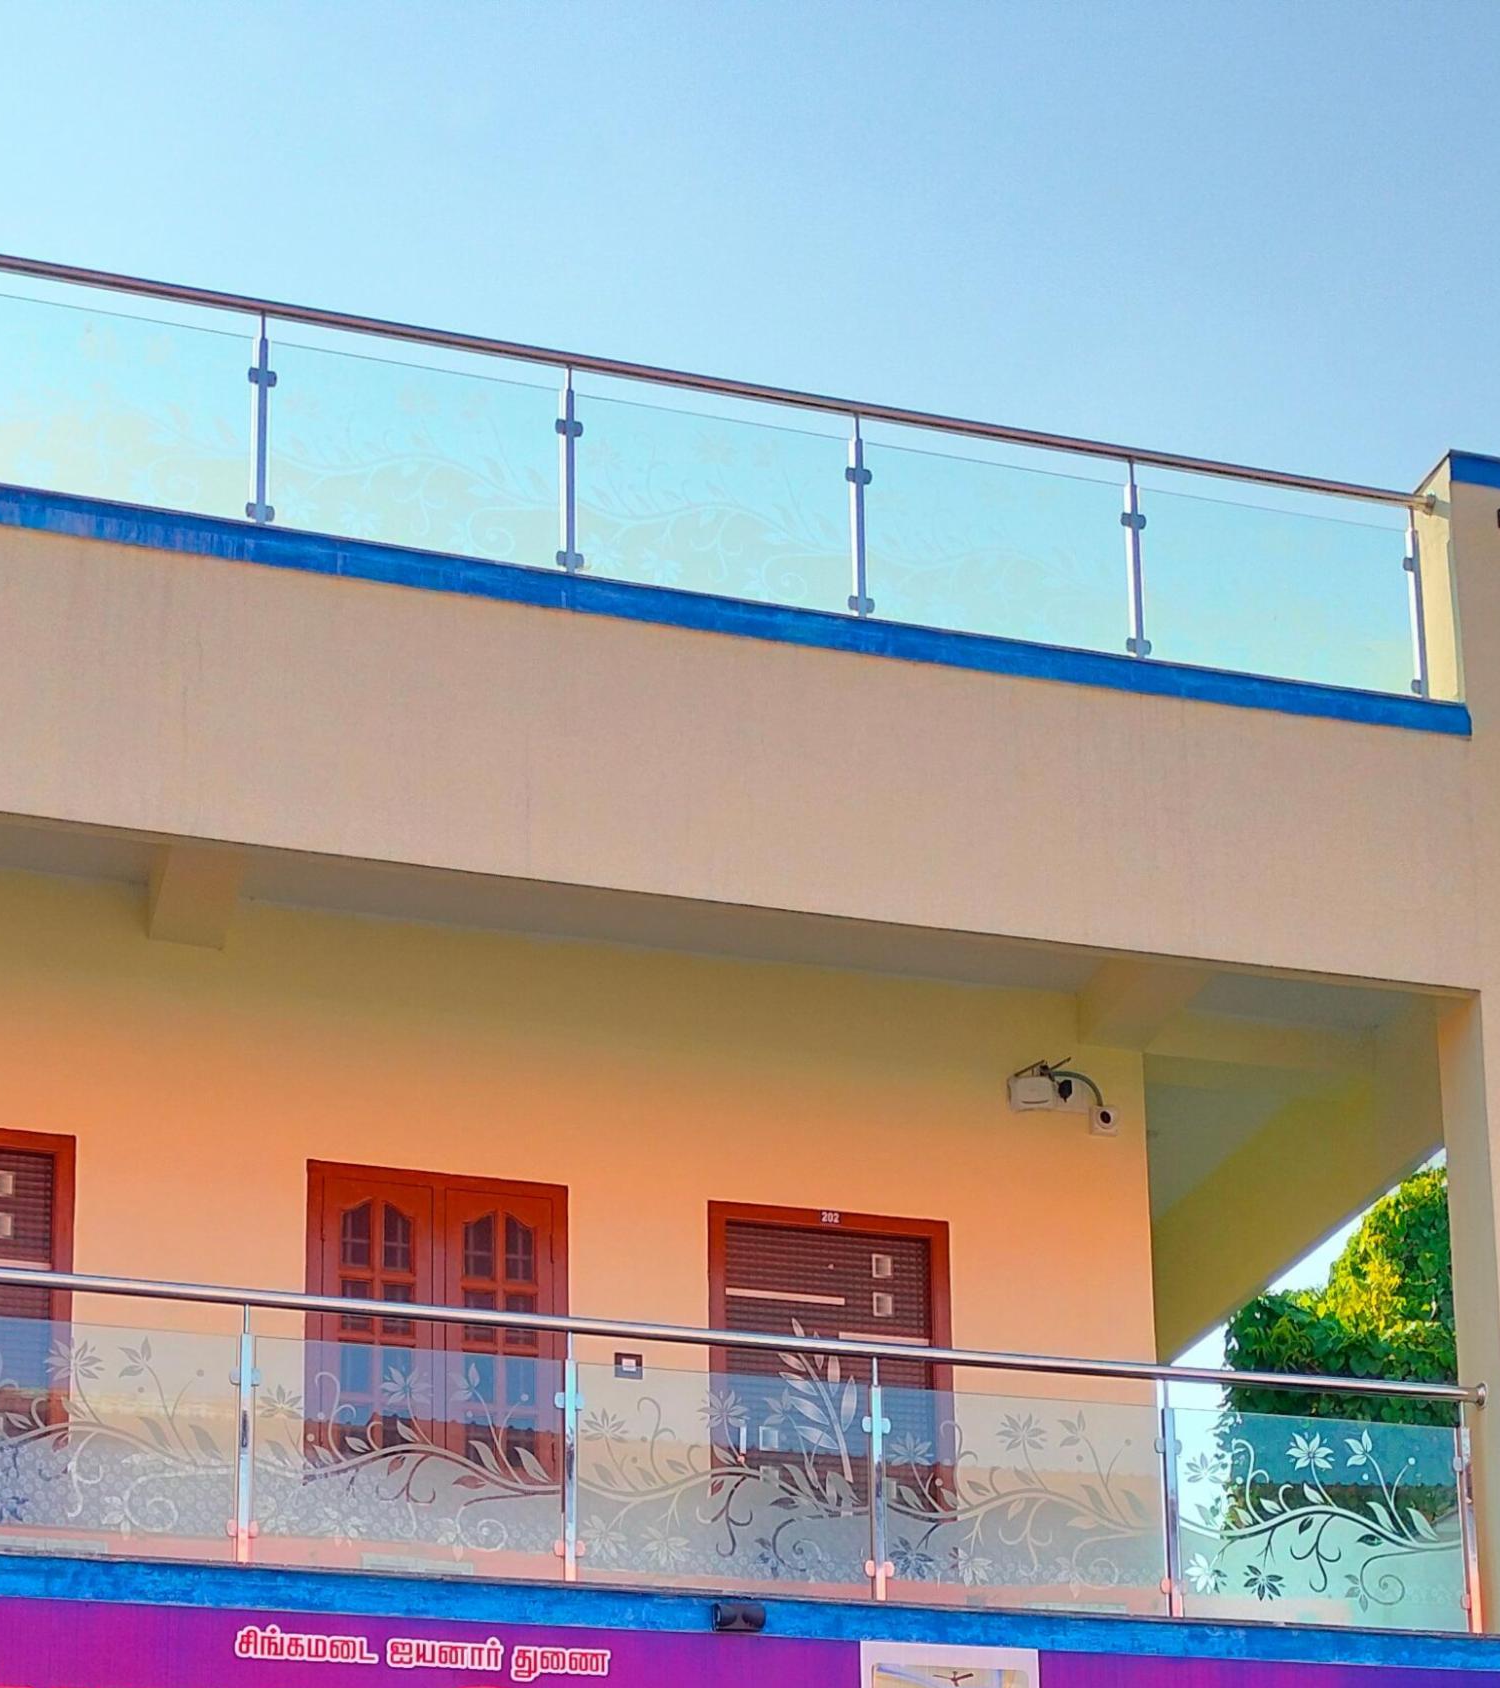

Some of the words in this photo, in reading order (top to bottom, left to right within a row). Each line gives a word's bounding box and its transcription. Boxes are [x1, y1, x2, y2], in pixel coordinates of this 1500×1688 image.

[821, 1211, 840, 1223] 202
[235, 1624, 379, 1664] சிங்கமடை
[386, 1637, 504, 1671] ஐயனார்
[510, 1645, 612, 1682] துணை
